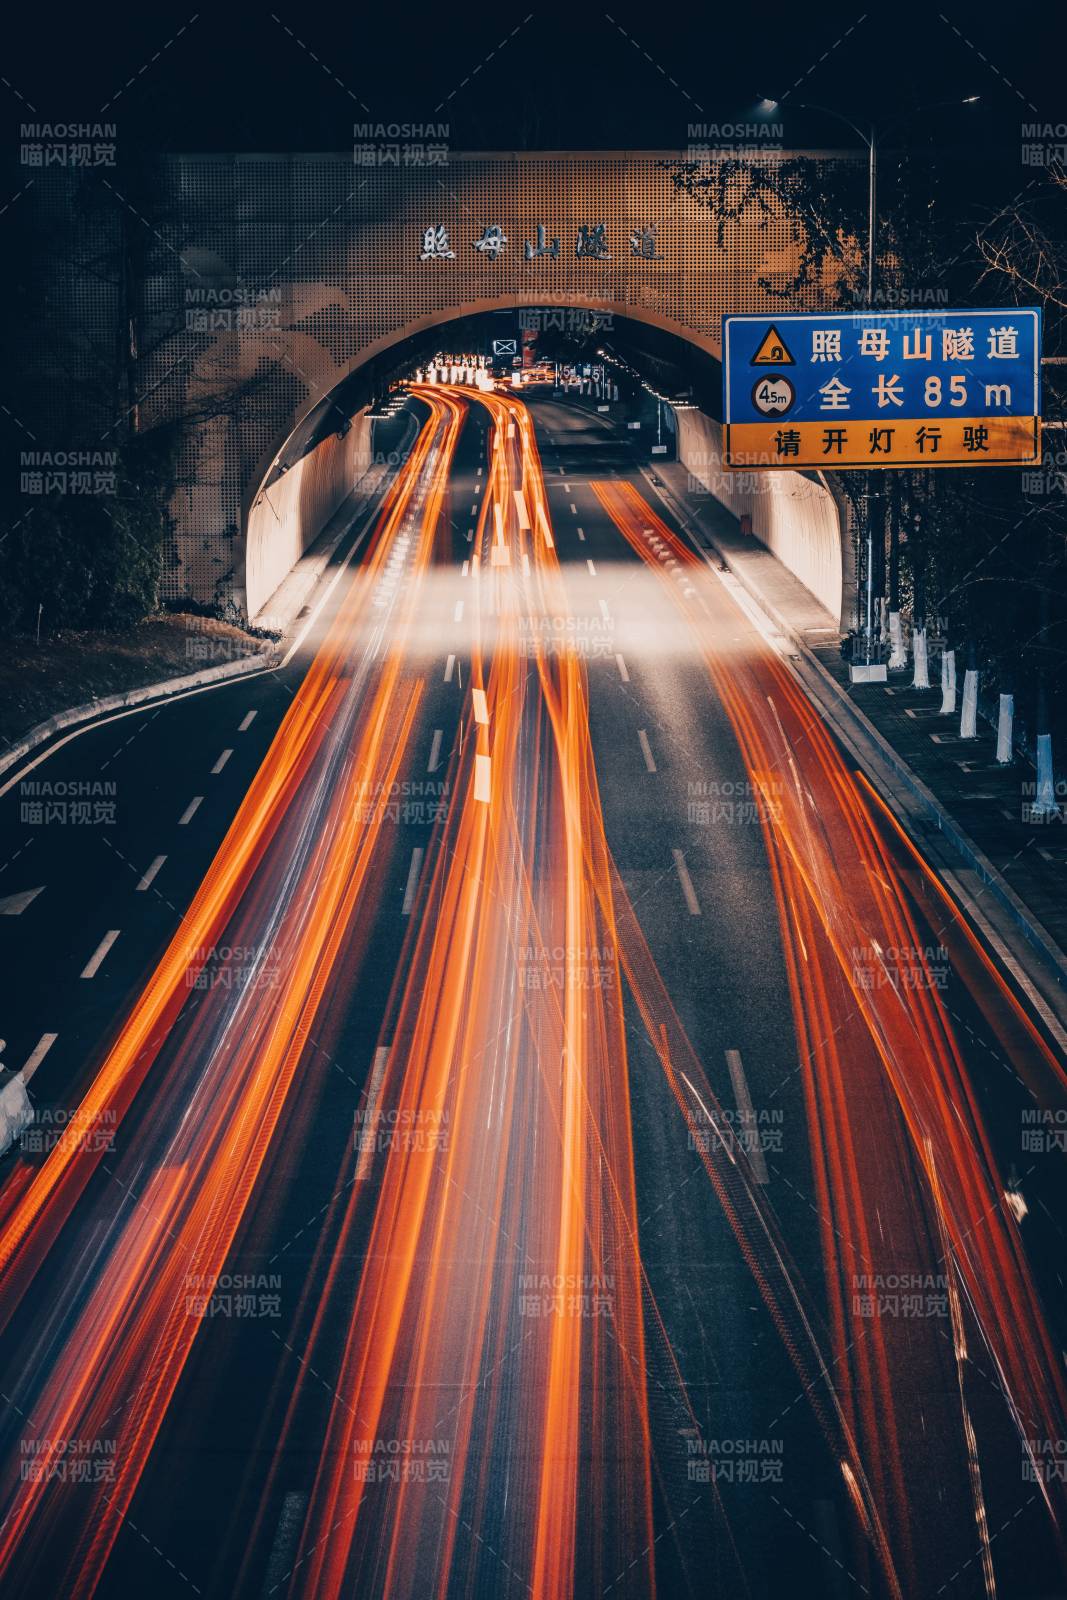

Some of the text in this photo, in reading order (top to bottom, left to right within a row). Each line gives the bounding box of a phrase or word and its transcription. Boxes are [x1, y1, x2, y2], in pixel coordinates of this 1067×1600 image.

[419, 223, 665, 261] 照母山隧道
[810, 326, 1020, 362] 照母山隧道
[774, 424, 989, 457] 请开灯行驶
